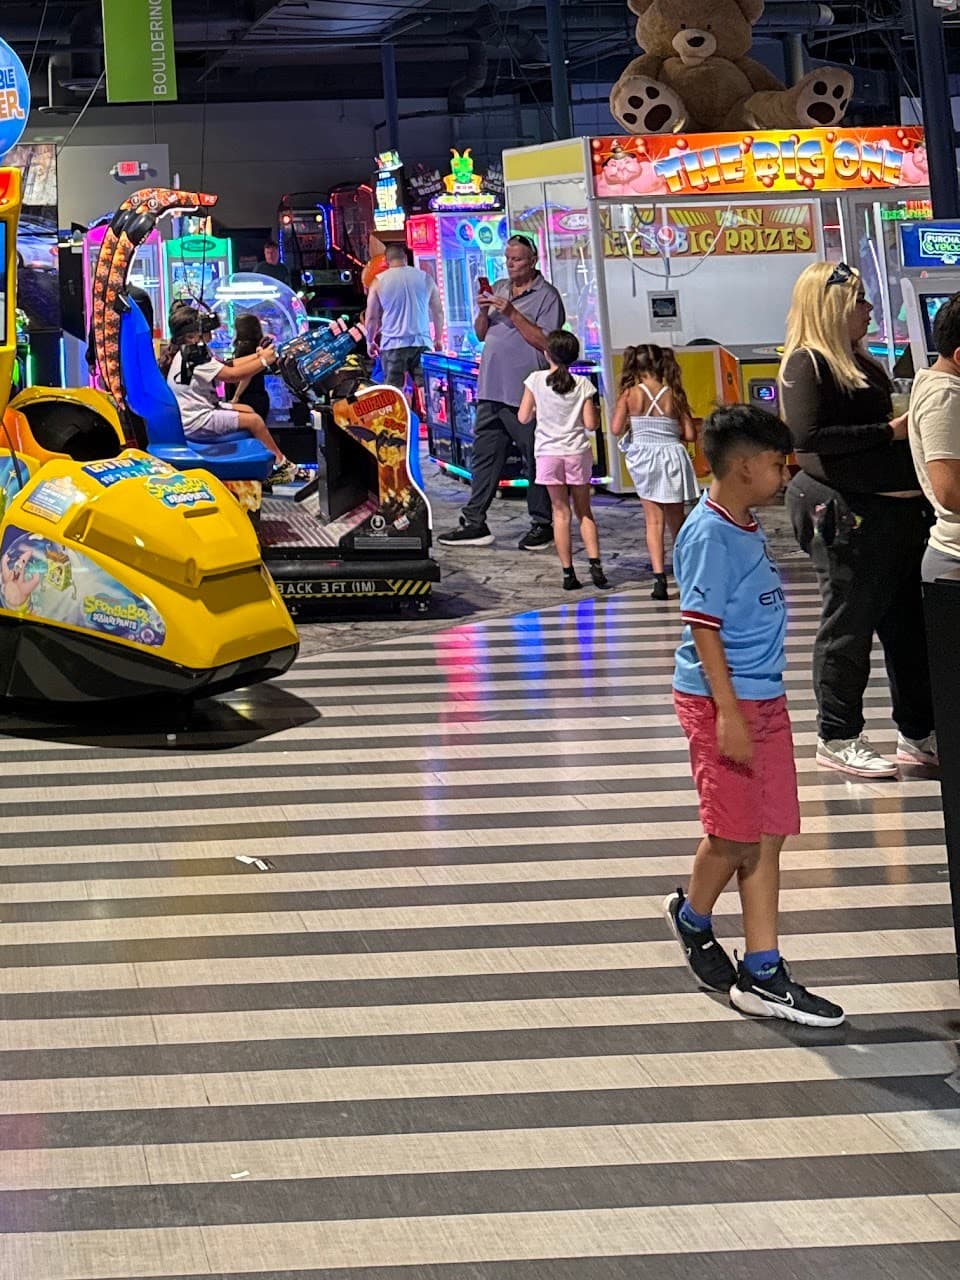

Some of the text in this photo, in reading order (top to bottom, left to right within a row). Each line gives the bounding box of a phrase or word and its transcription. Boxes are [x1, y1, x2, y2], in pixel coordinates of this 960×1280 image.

[652, 138, 905, 193] THE BIG ONE
[675, 226, 814, 256] BIG PRIZES
[926, 234, 960, 244] PURCHA
[353, 390, 397, 417] GODZILLA
[351, 581, 376, 593] (1M)
